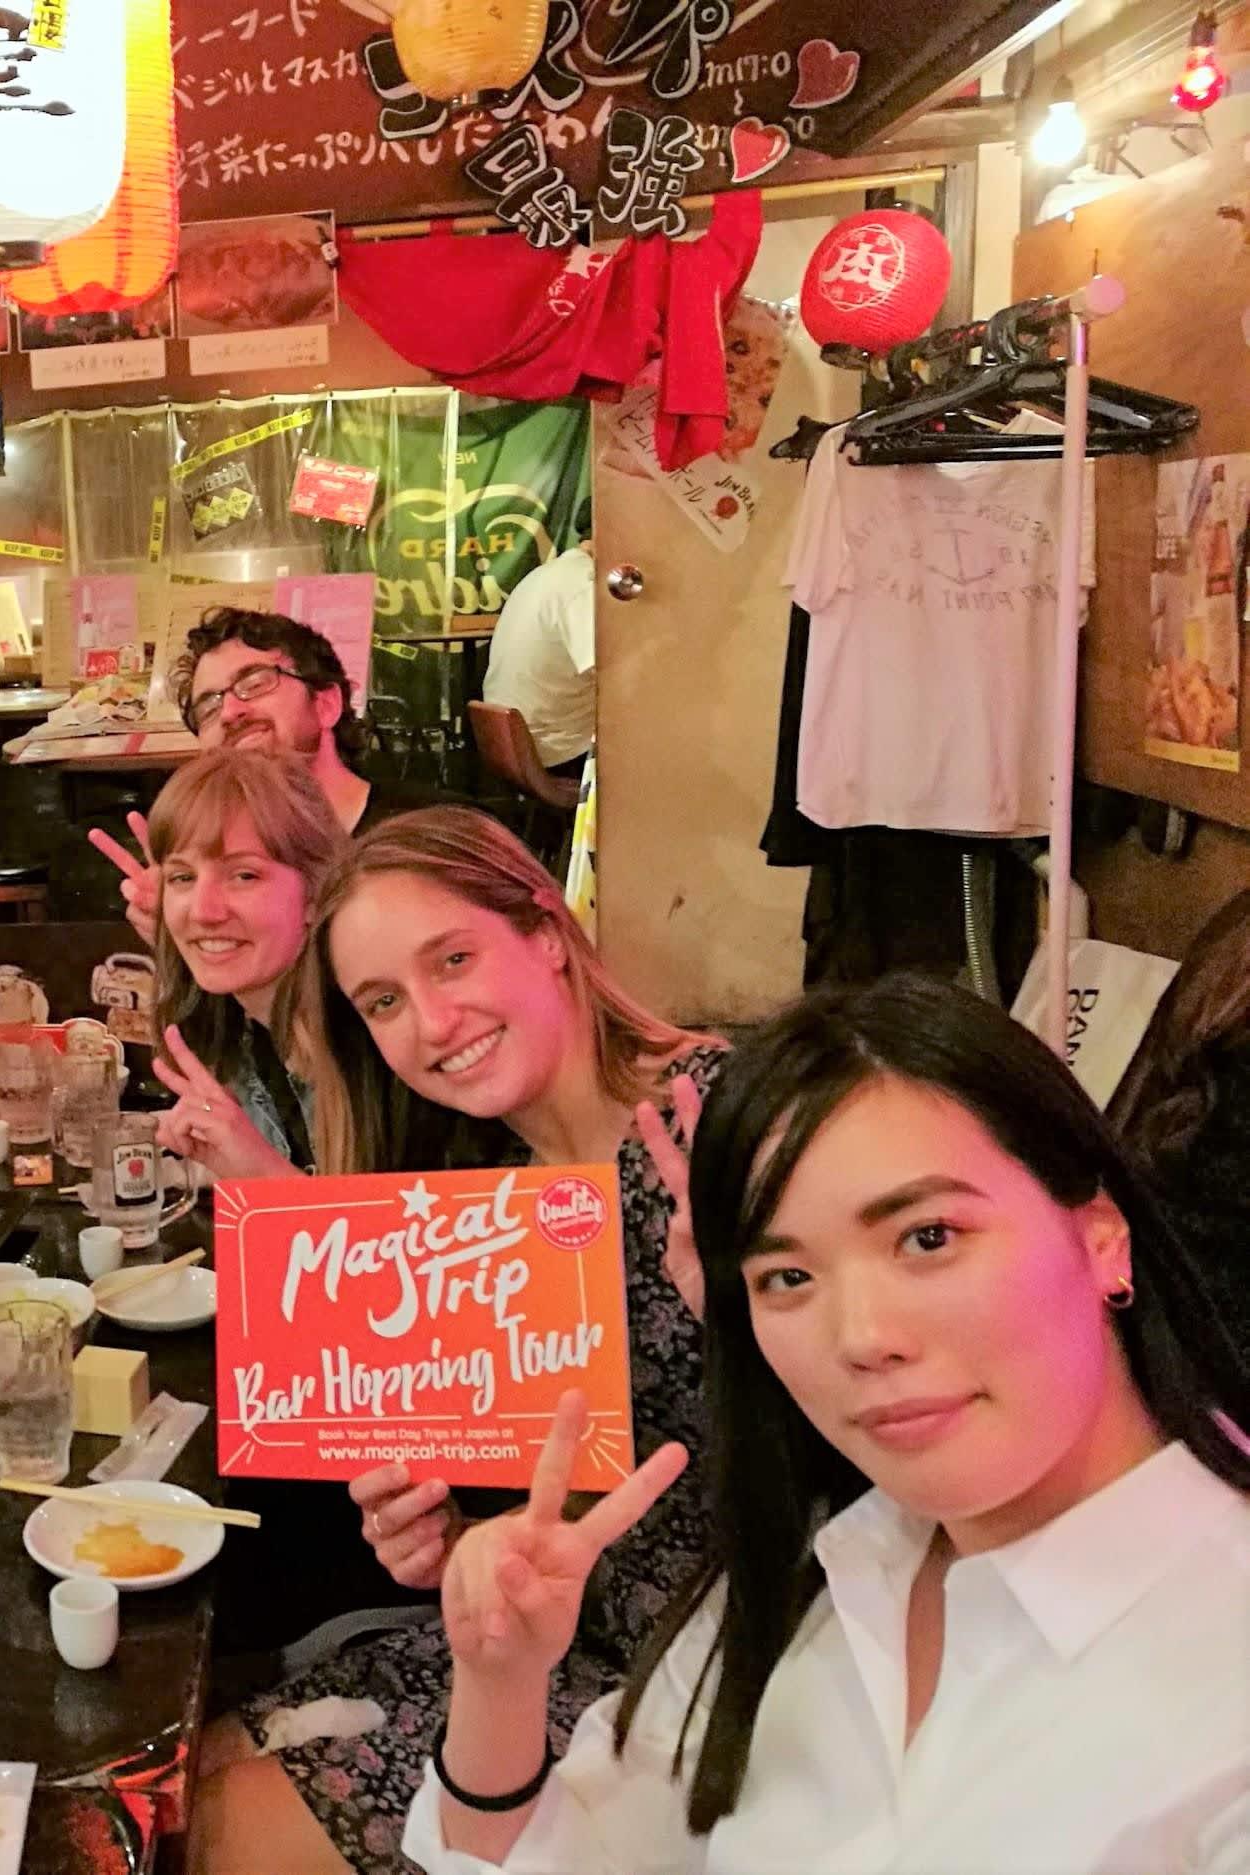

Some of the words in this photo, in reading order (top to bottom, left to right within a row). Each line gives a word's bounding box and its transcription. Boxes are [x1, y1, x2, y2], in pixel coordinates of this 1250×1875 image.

[465, 107, 706, 249] 最強
[281, 1171, 522, 1338] Magical
[415, 1227, 530, 1329] Trip
[233, 1362, 315, 1433] Bar
[321, 1339, 496, 1418] Hopping
[494, 1313, 603, 1384] Tour
[318, 1443, 521, 1463] www.magical-trip.com
[347, 1430, 371, 1441] Your
[373, 1429, 396, 1440] Best
[398, 1429, 421, 1441] Day
[423, 1429, 450, 1441] Trips
[466, 1429, 500, 1441] Japan
